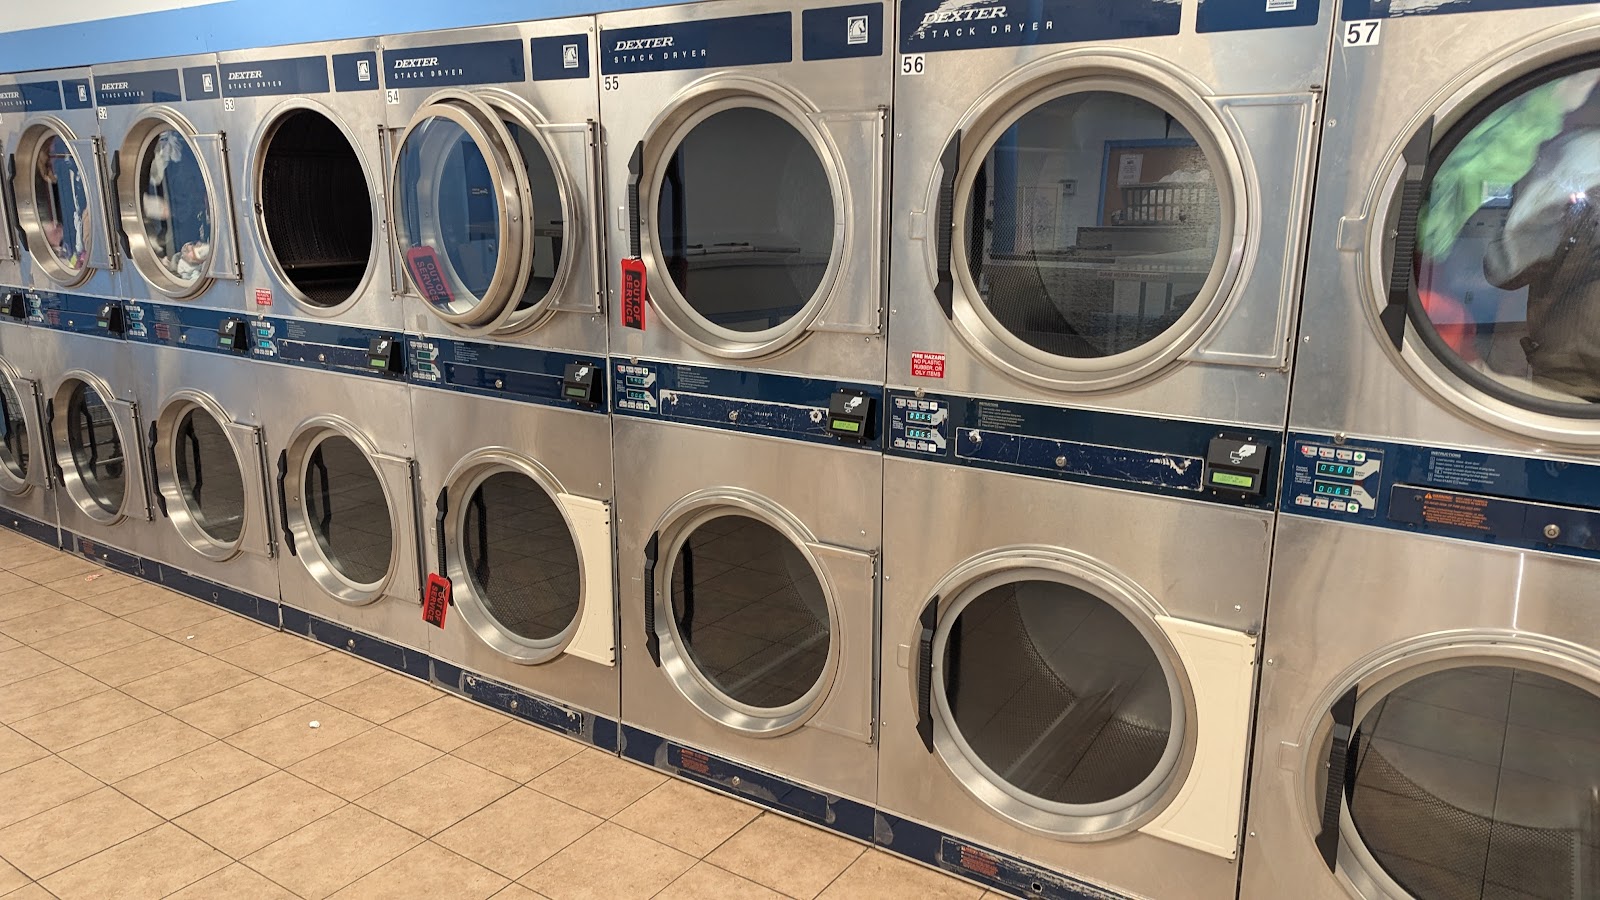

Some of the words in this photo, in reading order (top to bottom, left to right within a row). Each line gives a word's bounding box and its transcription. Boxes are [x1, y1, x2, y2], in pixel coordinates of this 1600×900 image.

[921, 6, 1006, 24] DEXTER
[920, 27, 976, 39] STACK
[991, 21, 1053, 34] DRYER
[1347, 22, 1379, 44] 57
[614, 36, 674, 51] DEXTER
[394, 57, 438, 68] DEXTER
[614, 54, 654, 63] STACK
[663, 49, 706, 59] DRYER
[903, 57, 923, 73] 56
[228, 70, 262, 80] DEXTER
[394, 71, 424, 80] STACK
[431, 68, 463, 77] DRYER
[101, 82, 128, 90] DEXTER
[604, 76, 619, 90] 55
[387, 90, 399, 103] 54
[225, 99, 235, 110] 53
[99, 108, 107, 118] 52
[417, 261, 440, 301] SERVICE
[427, 263, 440, 282] OUT
[436, 284, 446, 296] OF
[633, 305, 641, 321] OF
[427, 585, 438, 622] SERVICE
[437, 591, 445, 609] OUT
[434, 610, 441, 622] OF
